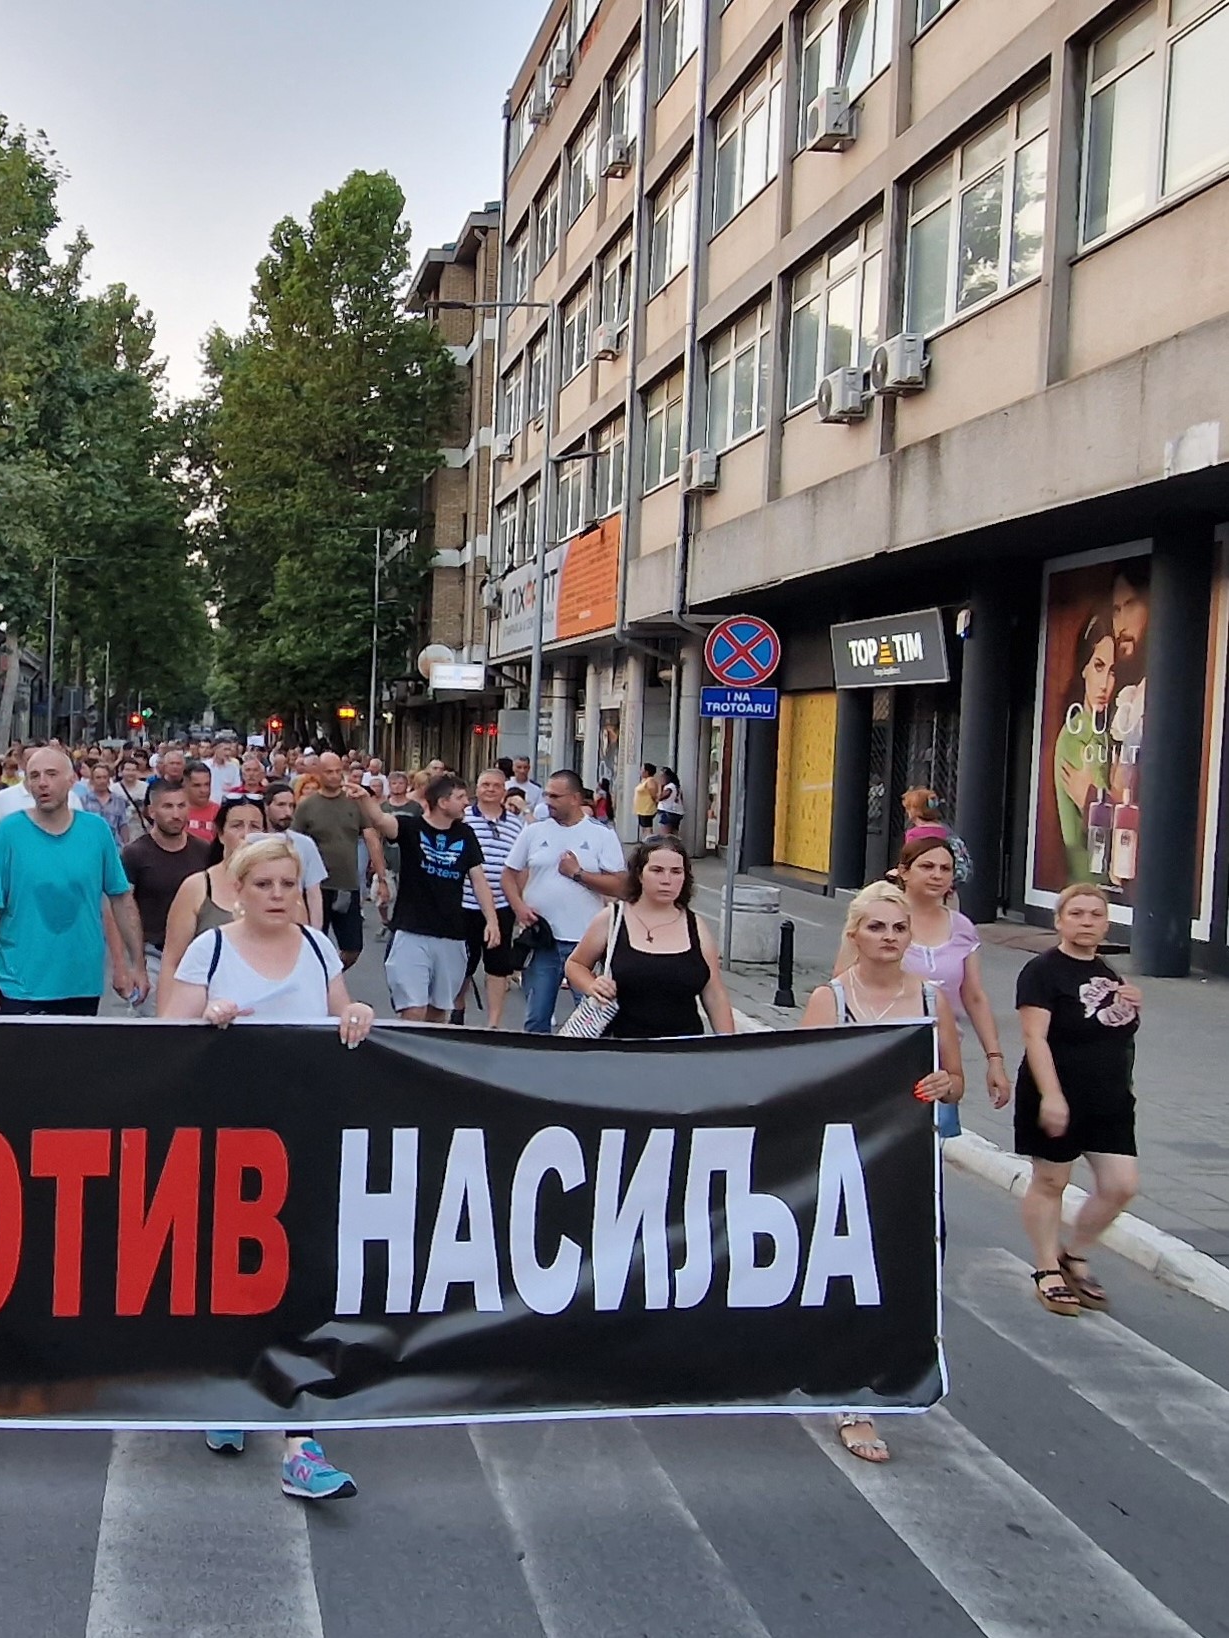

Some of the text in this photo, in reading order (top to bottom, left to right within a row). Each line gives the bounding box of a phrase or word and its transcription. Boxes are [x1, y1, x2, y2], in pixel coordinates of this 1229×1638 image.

[848, 632, 924, 667] TOP TIM
[727, 692, 750, 702] I NA
[705, 702, 771, 714] TROTOARU
[1084, 744, 1141, 764] GUILT
[336, 1124, 880, 1314] НАСИЉА
